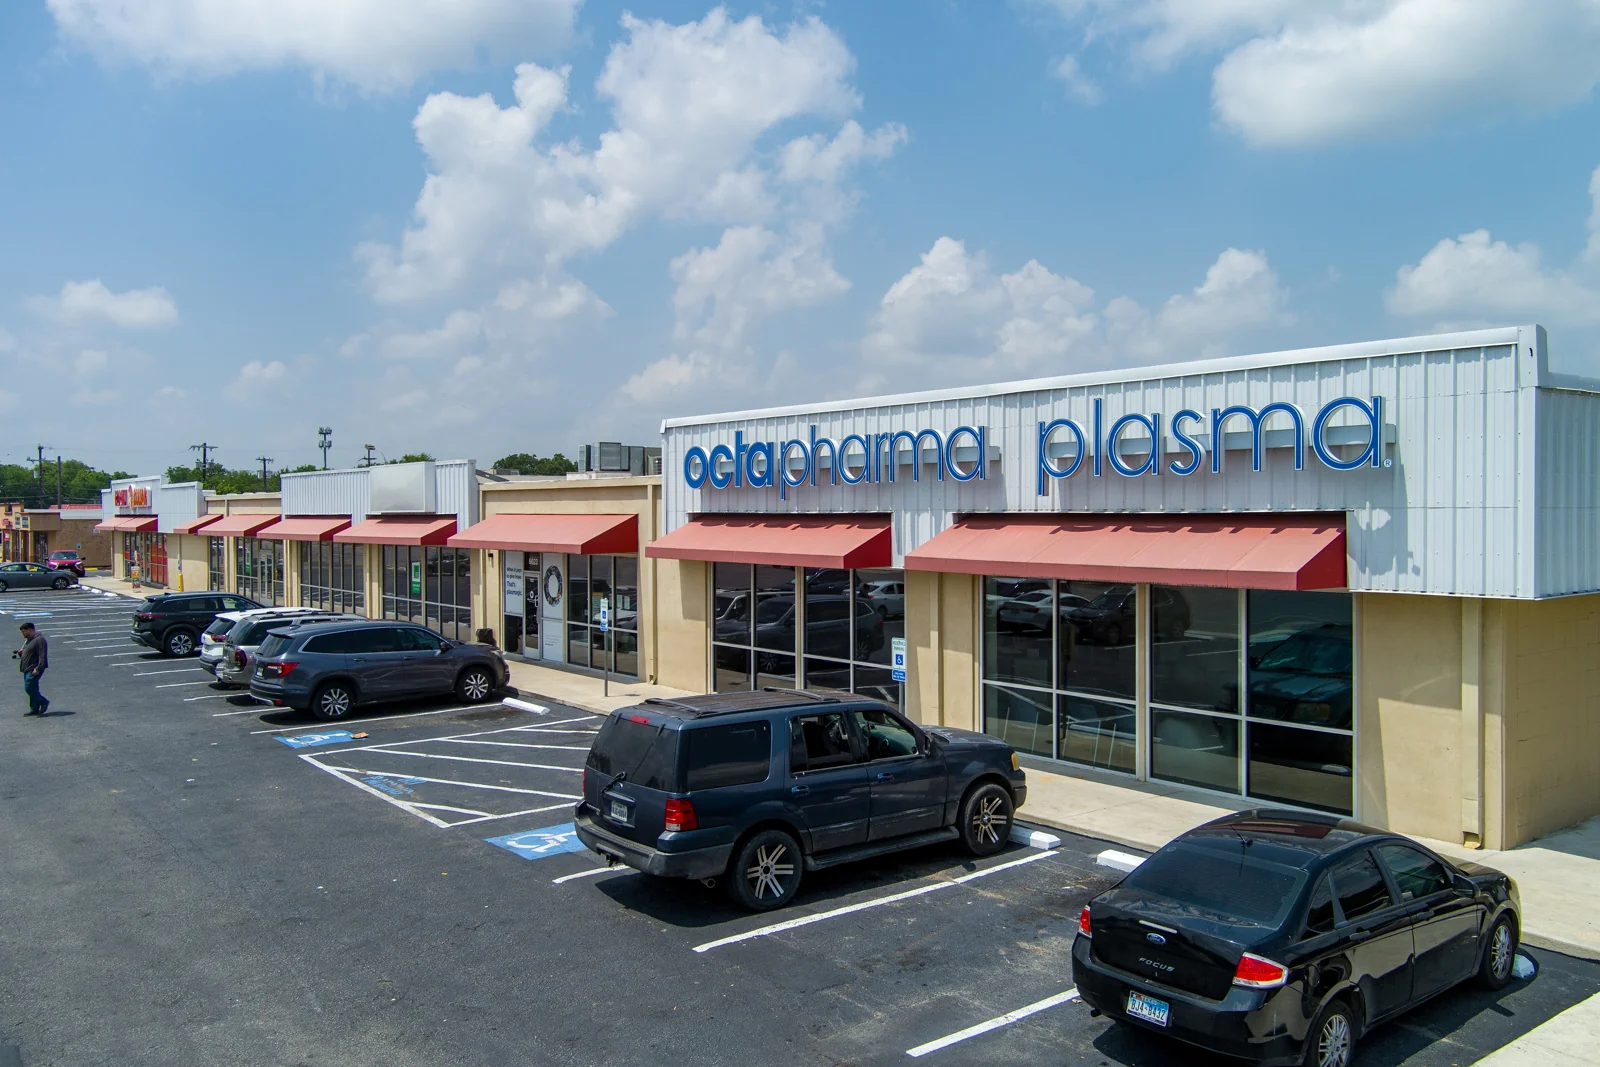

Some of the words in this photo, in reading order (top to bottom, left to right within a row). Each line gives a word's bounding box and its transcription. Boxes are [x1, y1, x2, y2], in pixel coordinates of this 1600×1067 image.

[684, 424, 986, 501] octapharma
[1036, 395, 1384, 497] plasma
[1139, 957, 1175, 972] FOCUS
